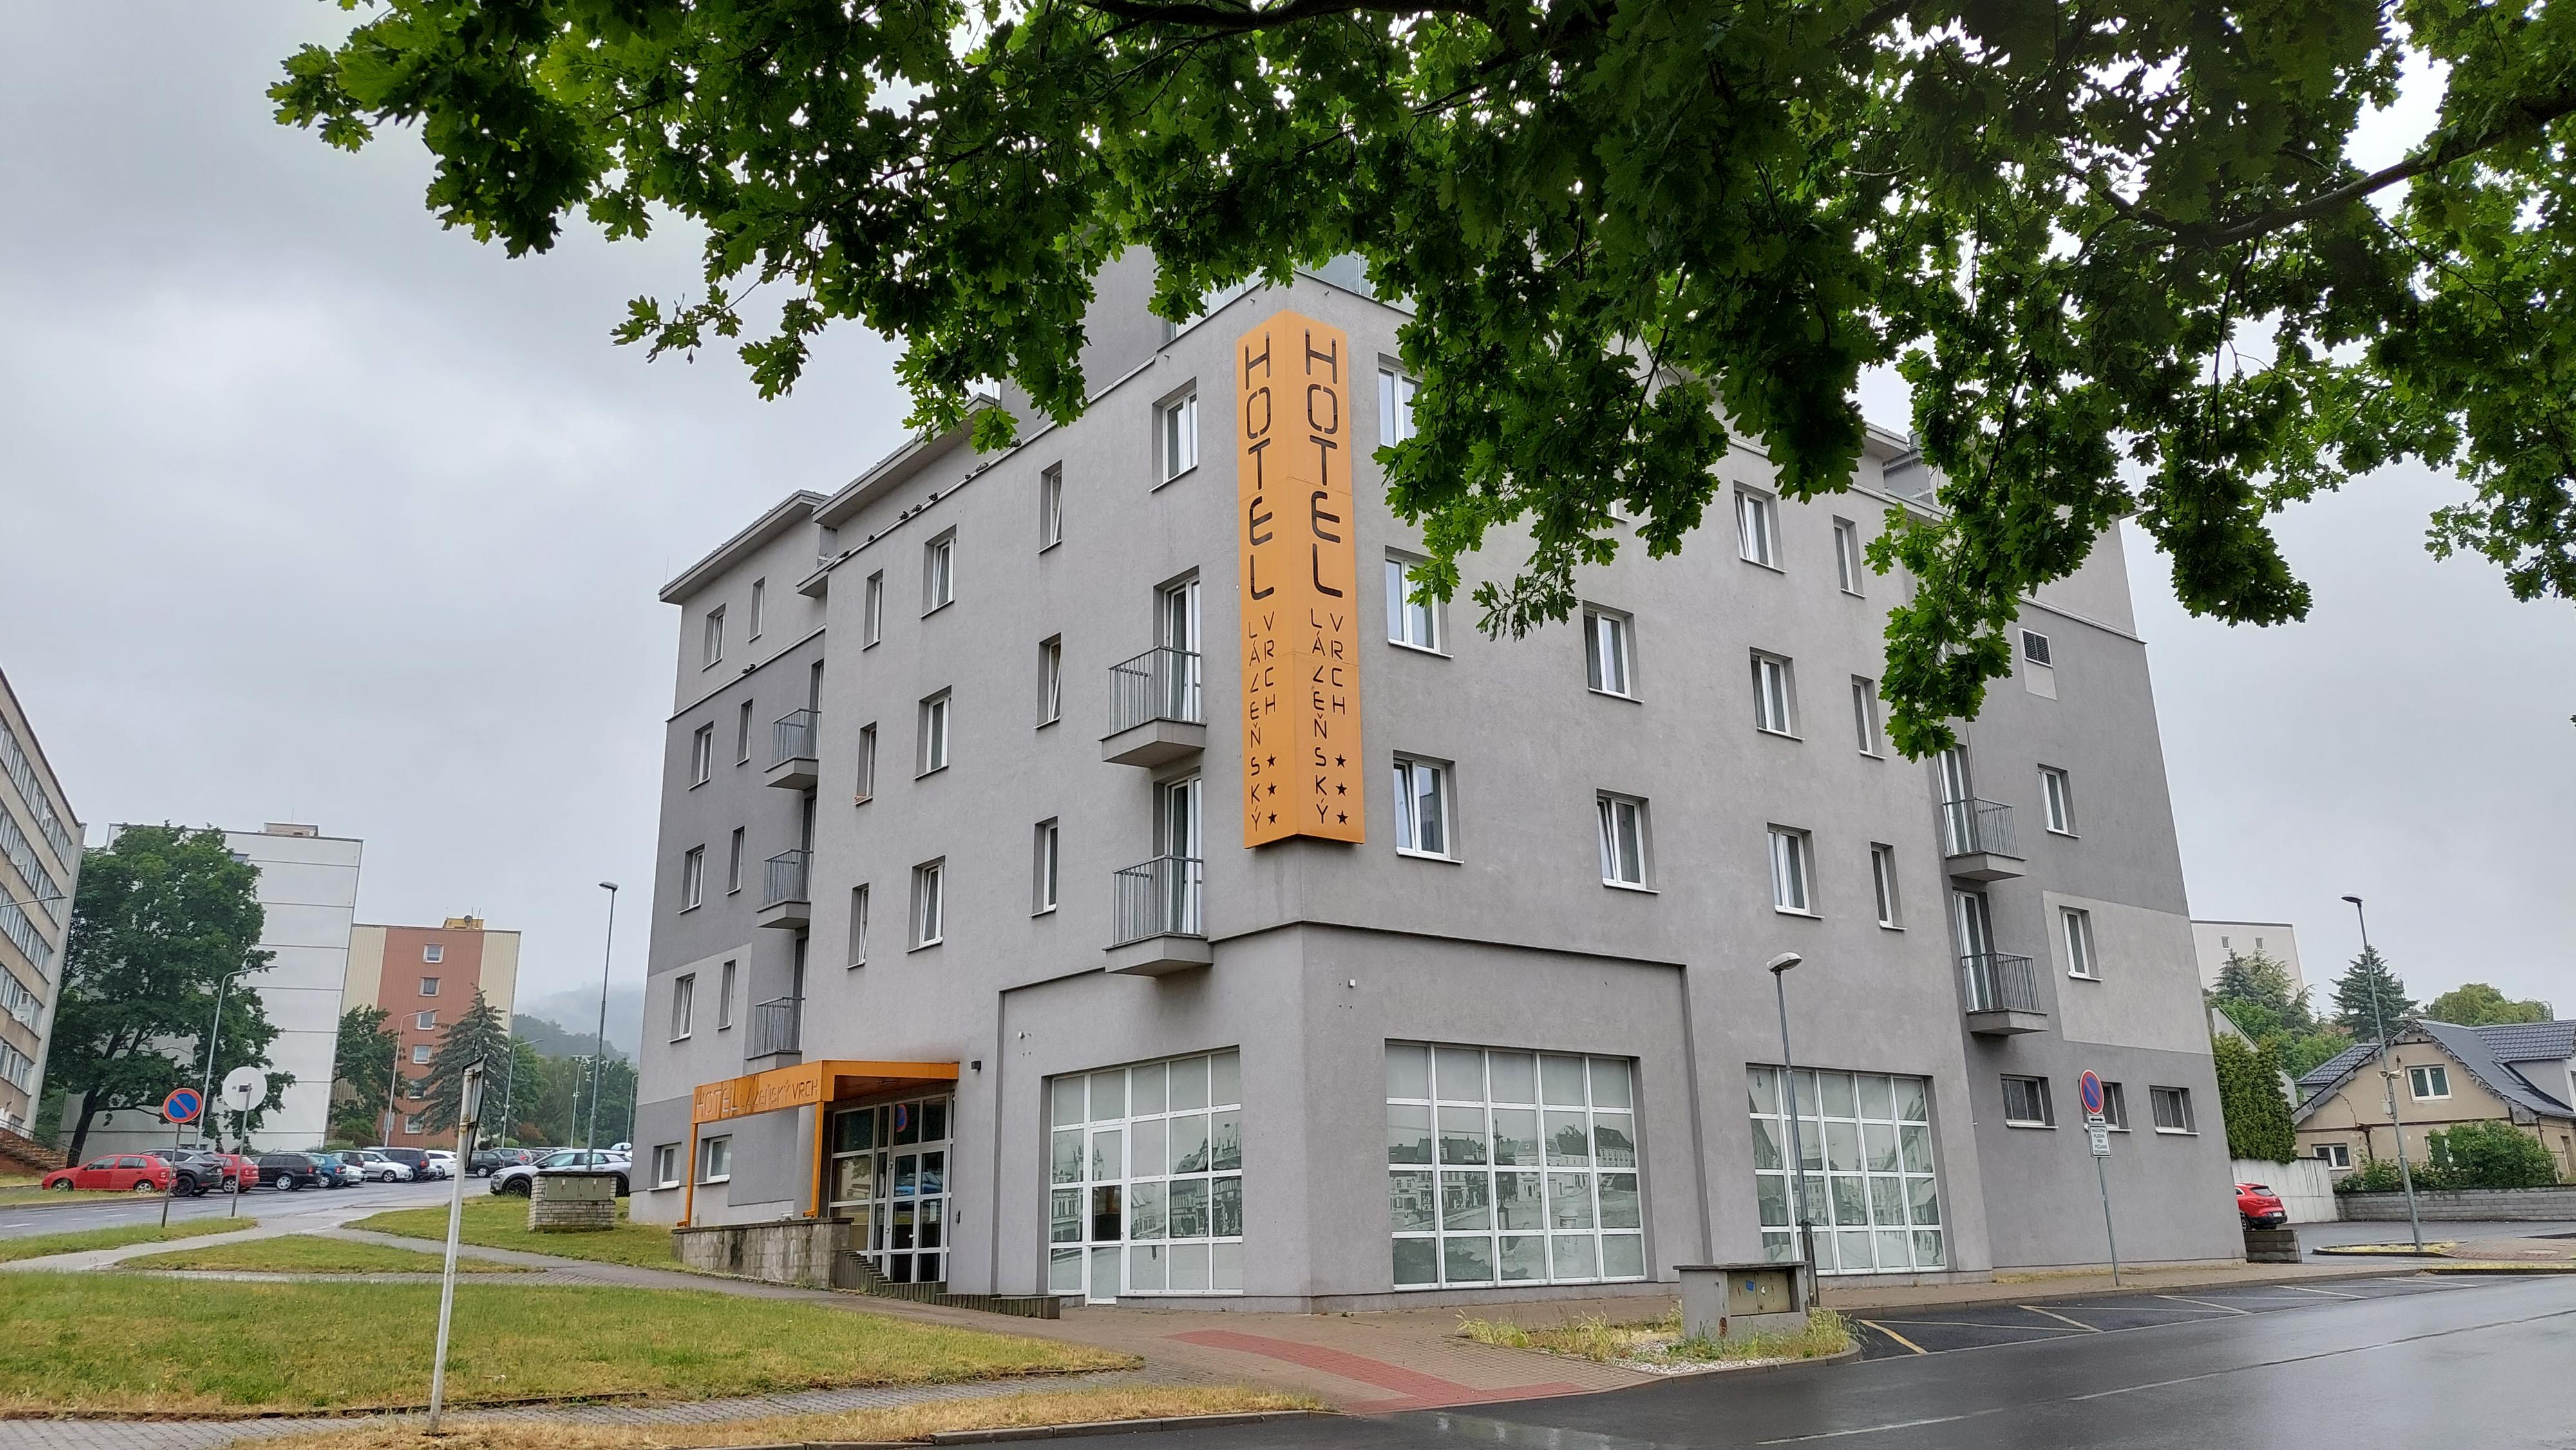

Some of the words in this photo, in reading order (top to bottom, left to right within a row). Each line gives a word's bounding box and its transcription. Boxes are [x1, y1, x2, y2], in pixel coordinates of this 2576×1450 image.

[1245, 331, 1274, 601] HOTEL
[1305, 328, 1343, 598] HOTEL
[1263, 610, 1276, 716] VRCH
[1329, 612, 1346, 715] VRCH
[696, 1086, 738, 1118] HOTEL
[791, 1079, 819, 1100] VRCH
